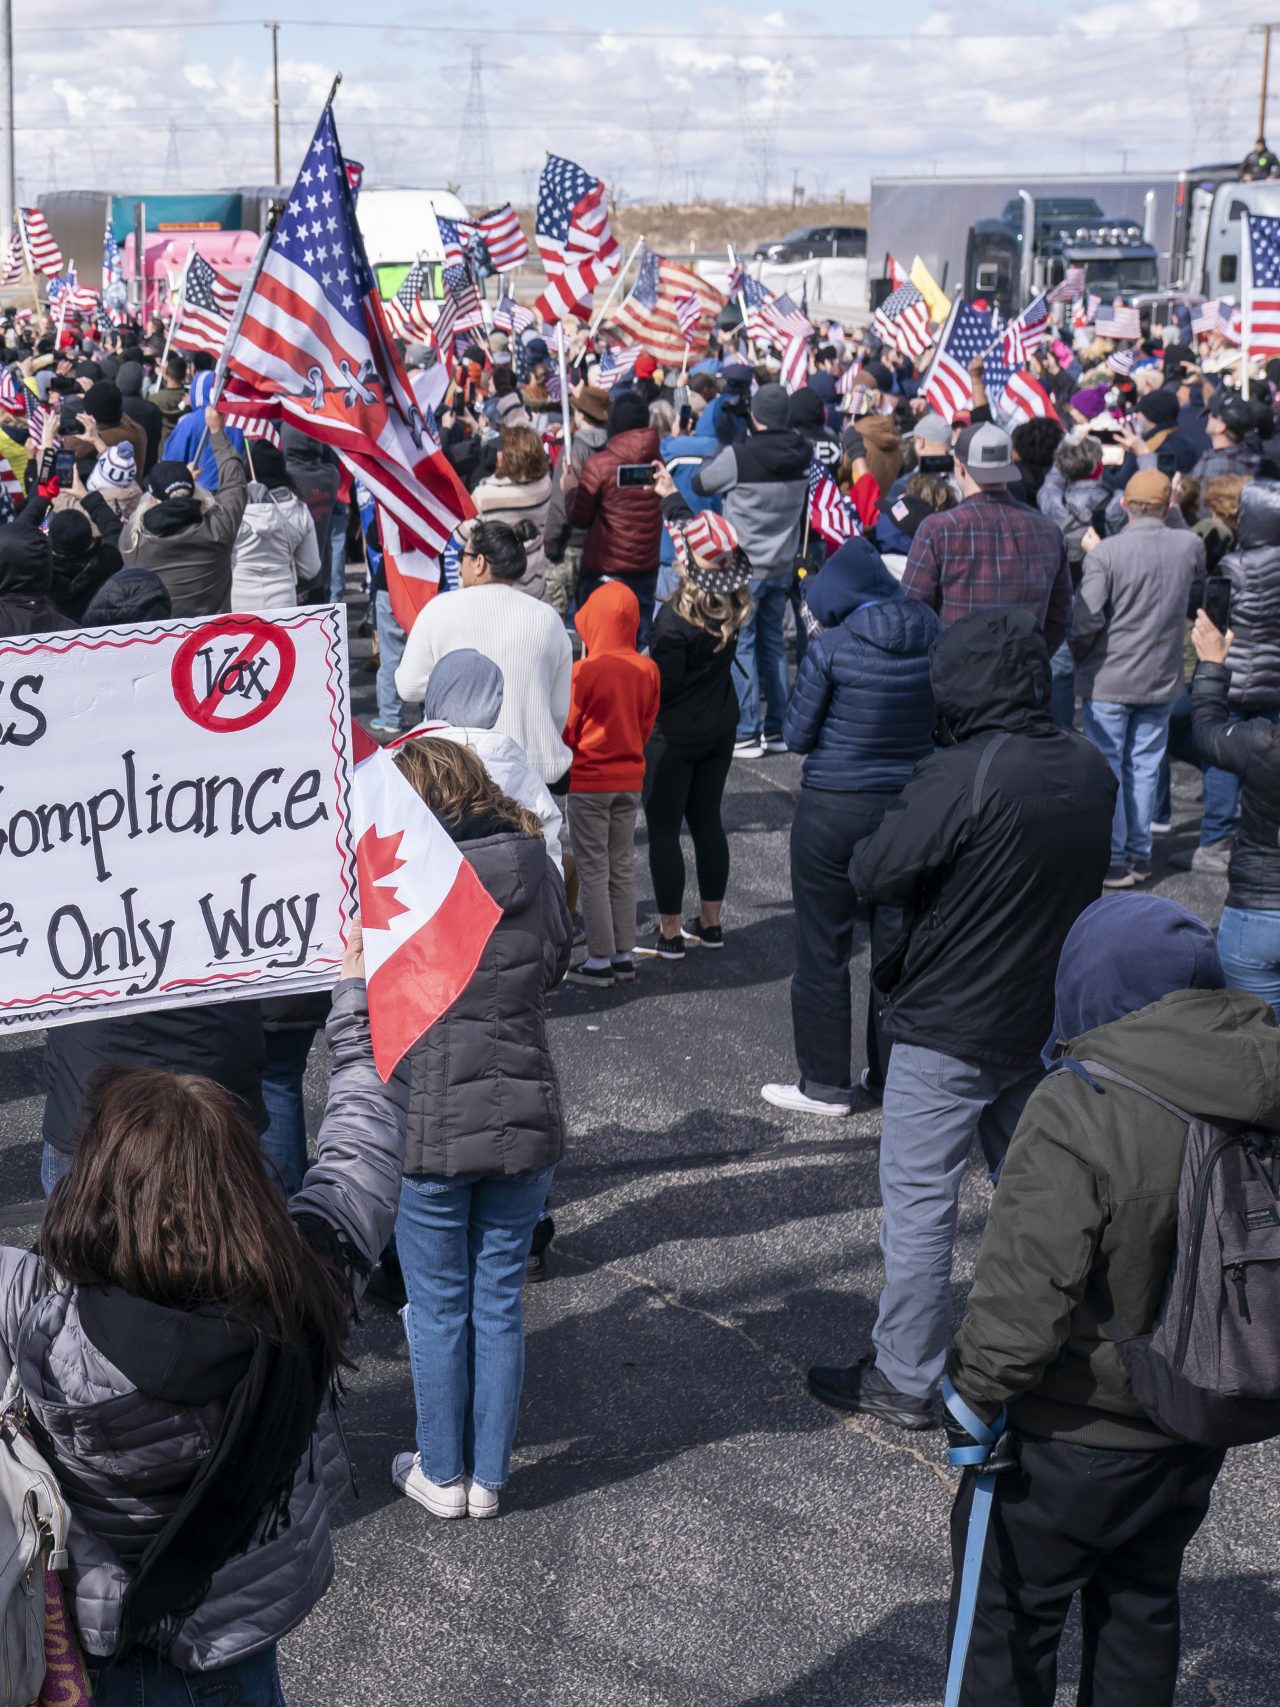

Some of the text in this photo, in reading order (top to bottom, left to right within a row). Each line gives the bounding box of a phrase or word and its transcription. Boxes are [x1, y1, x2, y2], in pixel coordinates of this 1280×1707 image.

[196, 647, 271, 702] Vax
[47, 888, 175, 995] Only
[199, 874, 320, 968] Way
